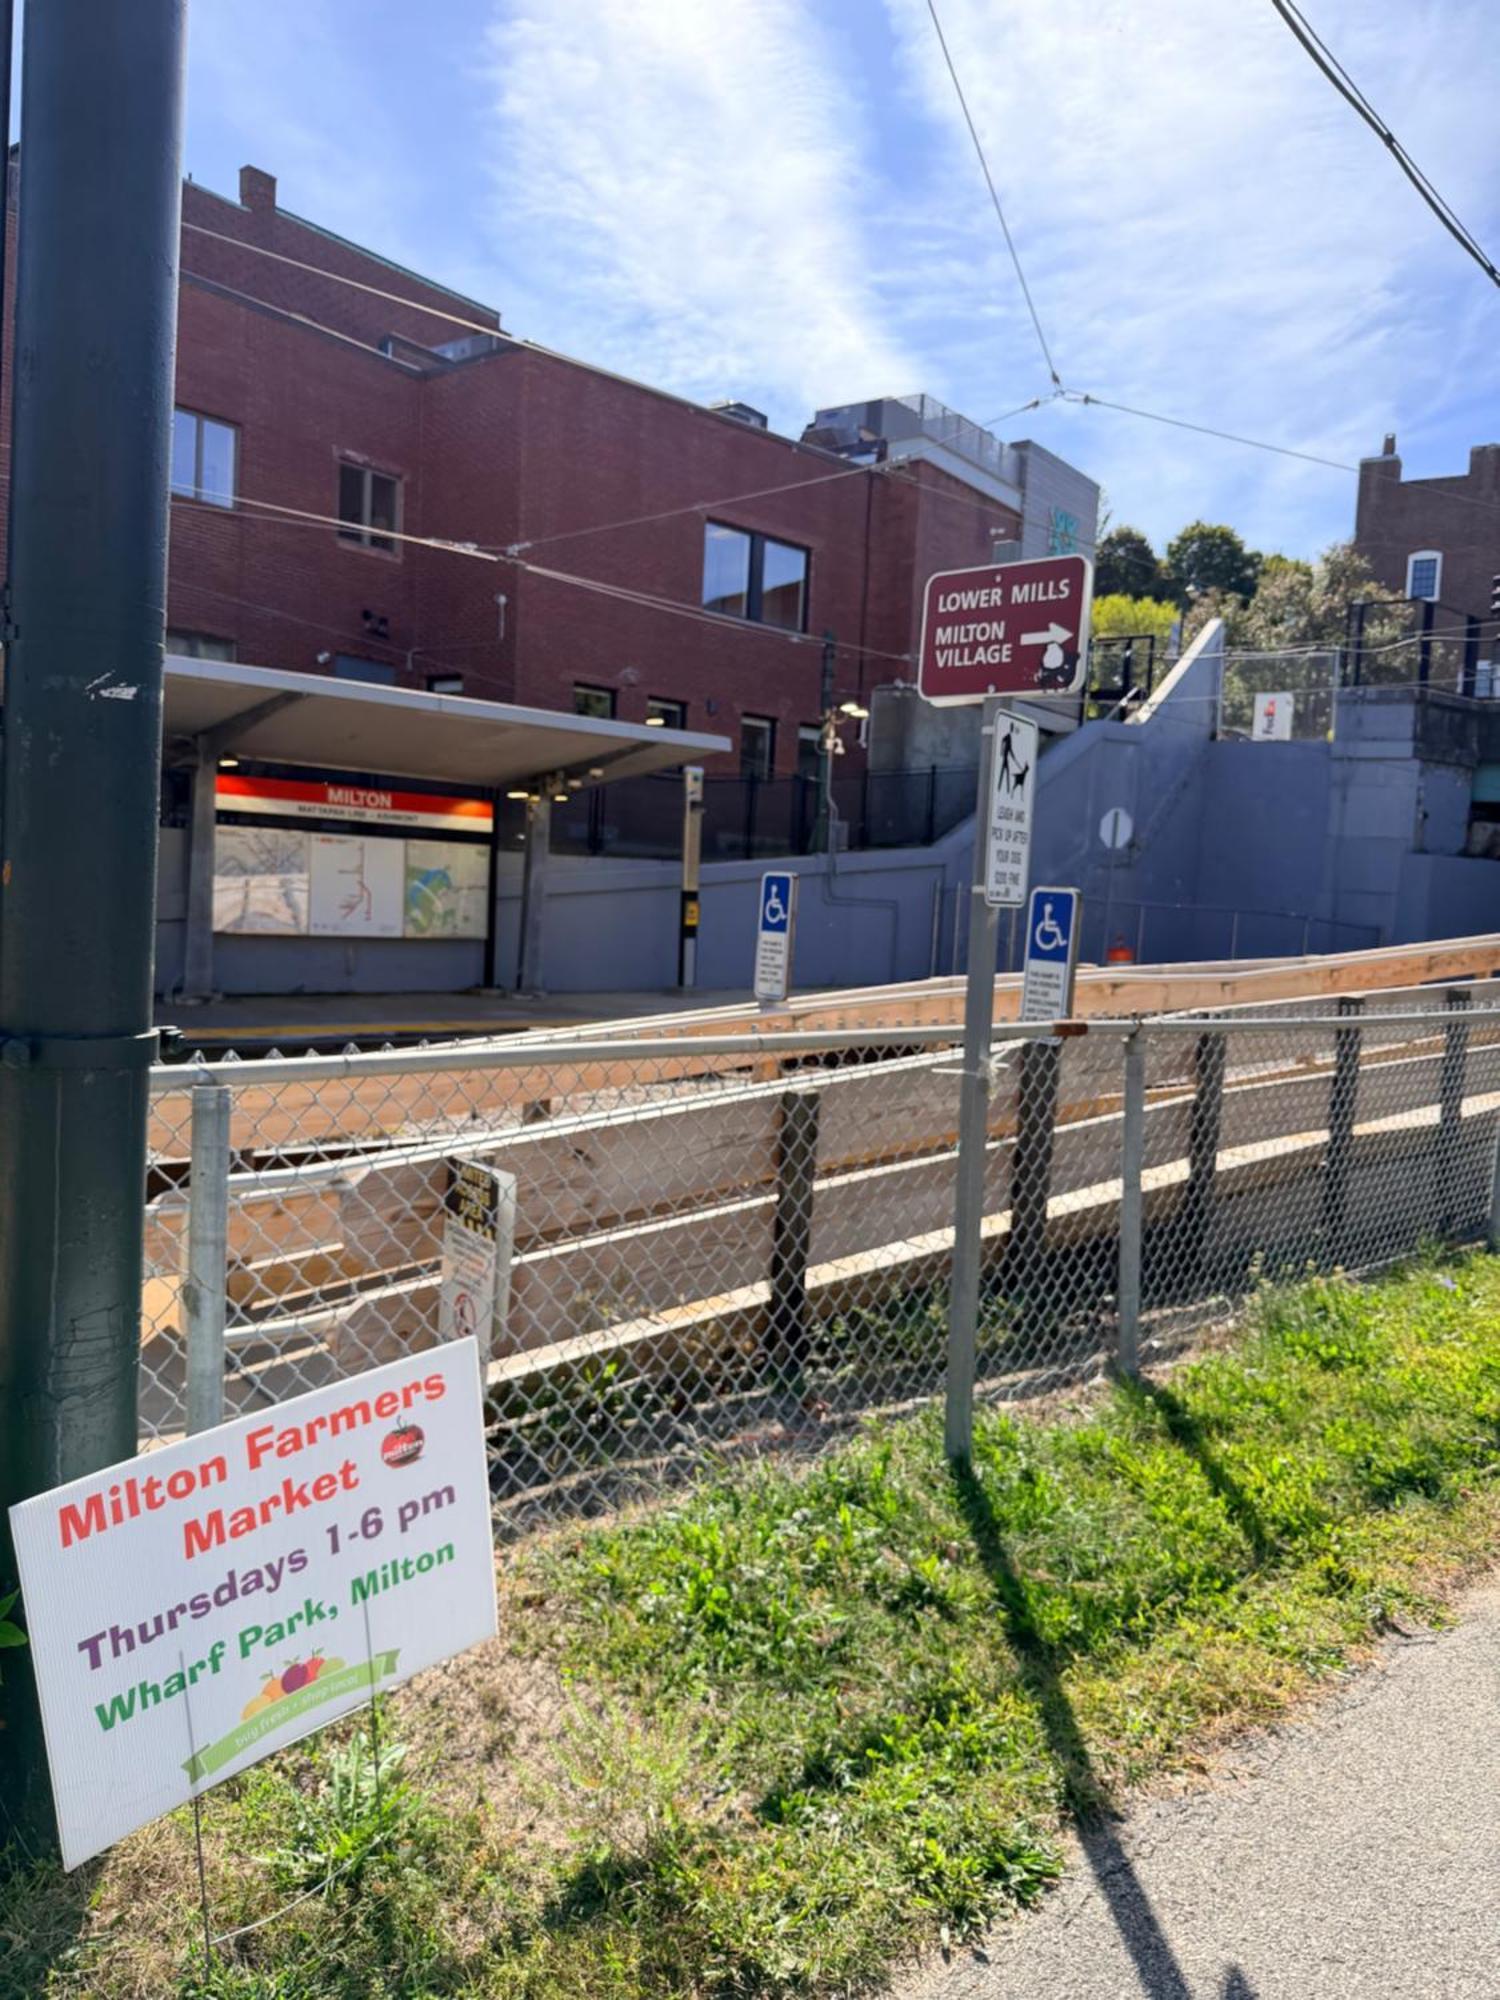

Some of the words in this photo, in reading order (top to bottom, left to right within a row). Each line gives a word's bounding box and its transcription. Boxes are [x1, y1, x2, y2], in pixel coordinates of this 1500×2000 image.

[938, 588, 1002, 613] LOWER
[1011, 579, 1070, 605] MILLS
[935, 621, 1005, 646] MILTON
[935, 644, 1012, 668] VILLAGE
[327, 786, 392, 809] MILTON
[58, 1454, 228, 1548] Milton
[246, 1373, 447, 1470] Farmers
[183, 1459, 360, 1560] Market
[78, 1549, 308, 1670] Thursdays
[327, 1507, 384, 1555] 1-6
[399, 1485, 455, 1532] pm
[95, 1641, 226, 1732] Wharf
[238, 1597, 340, 1660] Park,
[351, 1542, 455, 1605] Milton
